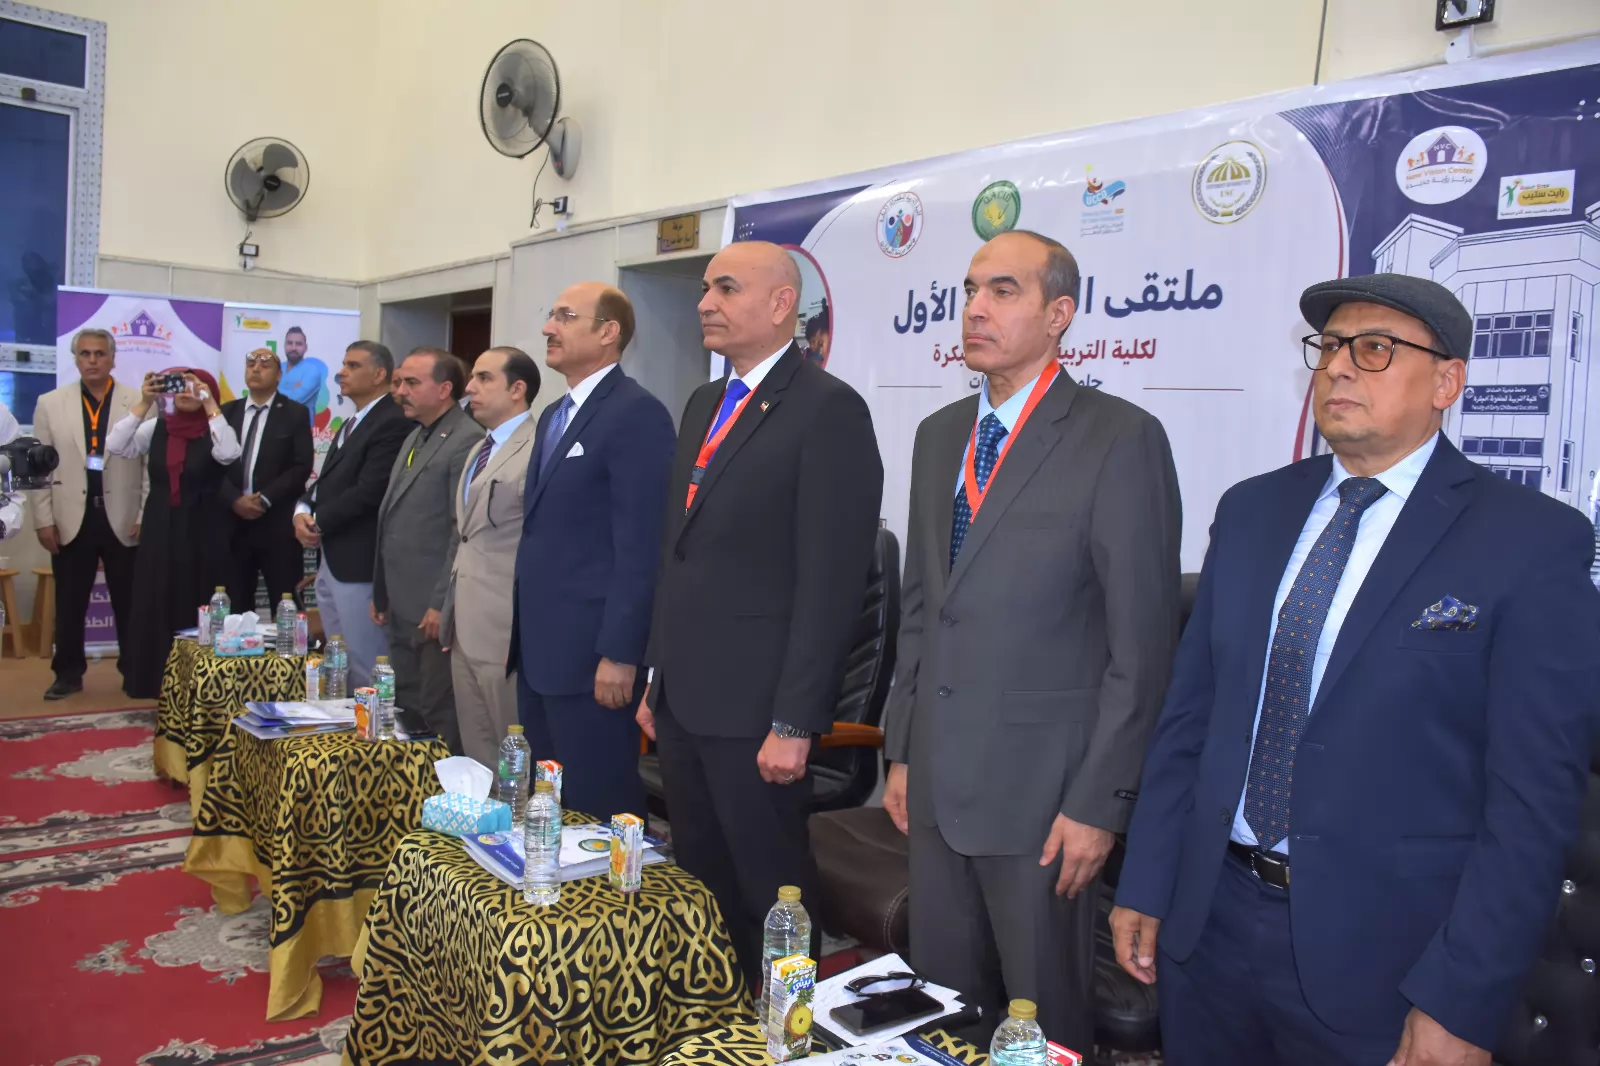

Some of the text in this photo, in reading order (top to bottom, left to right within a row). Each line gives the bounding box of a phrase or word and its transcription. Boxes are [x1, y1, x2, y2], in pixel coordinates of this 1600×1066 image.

[1086, 190, 1107, 205] UCCD
[893, 280, 957, 334] الأول
[1104, 269, 1223, 318] ملتقى
[933, 343, 965, 368] بكرة
[1111, 338, 1157, 365] لكلية
